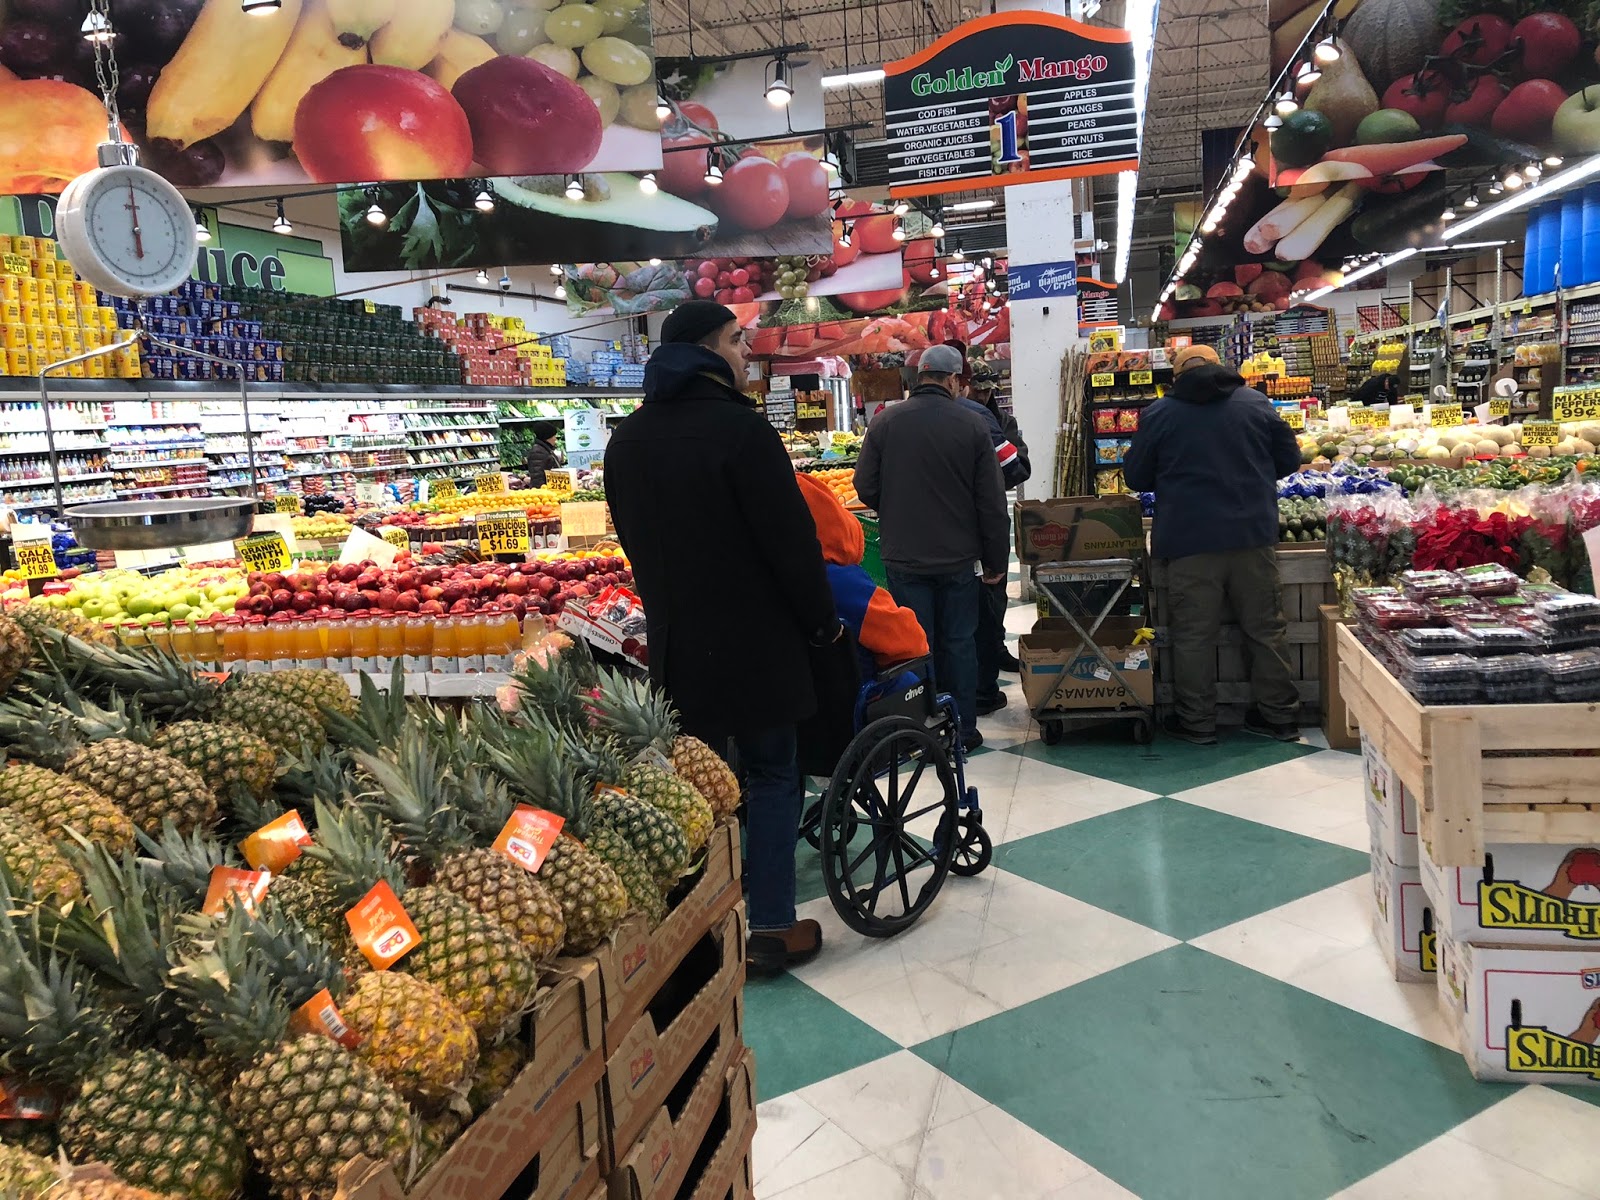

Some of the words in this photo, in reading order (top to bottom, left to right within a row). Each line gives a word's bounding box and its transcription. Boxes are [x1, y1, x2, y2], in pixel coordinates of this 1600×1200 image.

[911, 65, 1005, 96] Golden
[1017, 54, 1108, 83] Mango
[1064, 88, 1097, 100] APPLES
[918, 109, 936, 119] COD
[937, 107, 957, 117] FISH
[1060, 103, 1103, 115] ORANGES
[896, 118, 981, 137] WATER-VEGETABLES
[1067, 119, 1096, 129] PEARS
[904, 138, 942, 151] ORGANIC
[943, 135, 974, 146] JUICES
[994, 110, 1022, 164] 1
[1061, 136, 1079, 146] DRY
[1080, 133, 1104, 143] NUTS
[904, 156, 921, 166] DRY
[922, 149, 976, 163] VEGETABLES
[1072, 150, 1093, 159] RICE
[918, 168, 937, 178] FISH
[938, 165, 961, 176] DEPT.
[1038, 270, 1072, 288] Diamond
[1554, 391, 1600, 403] MIXED
[1561, 406, 1597, 419] 99¢
[1435, 418, 1457, 426] 2/$5
[476, 475, 500, 483] RUBY
[478, 525, 492, 533] RED
[493, 521, 526, 530] DELICIOUS
[481, 529, 527, 541] APPLES
[241, 542, 281, 556] GRANNY
[489, 538, 519, 552] $1.69
[1083, 540, 1138, 550] PLANTAINS
[18, 548, 51, 558] GALA
[244, 548, 284, 563] SMITH
[21, 555, 54, 566] APPLES
[254, 558, 282, 572] $1.99
[27, 563, 49, 577] $1.99
[904, 685, 925, 701] drive
[1054, 685, 1126, 700] BANANAS
[1489, 887, 1599, 935] FRUITS
[379, 930, 405, 954] Dole
